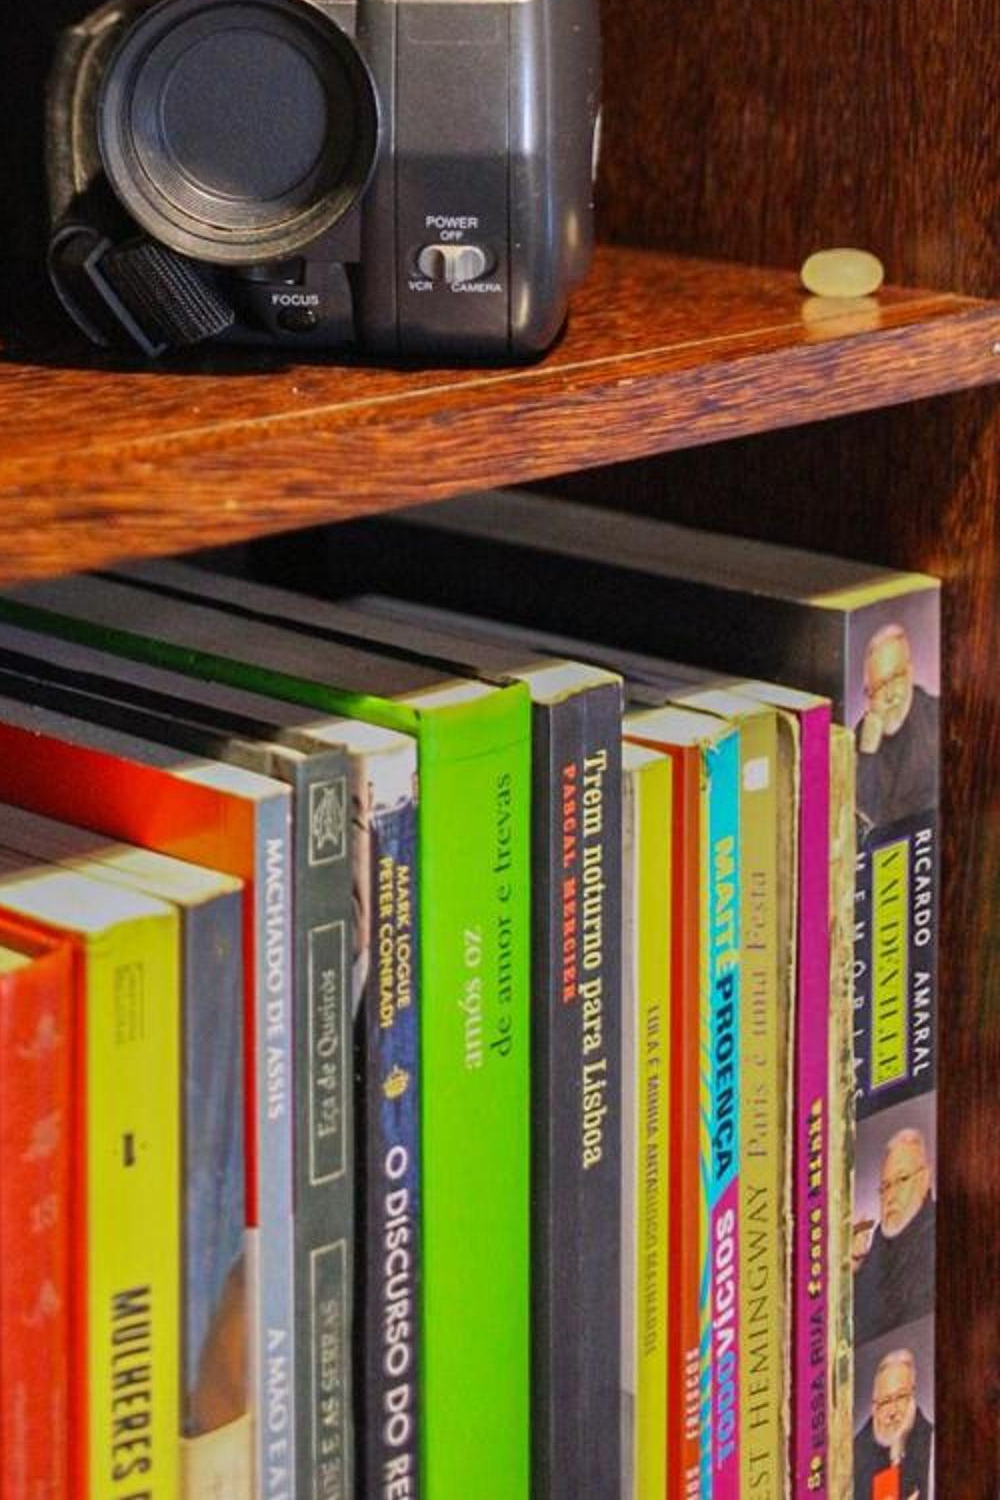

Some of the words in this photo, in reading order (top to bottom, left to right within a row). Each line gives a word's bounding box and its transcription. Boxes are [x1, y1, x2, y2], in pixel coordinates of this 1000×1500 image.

[426, 216, 478, 229] POWER
[440, 230, 463, 241] OFF
[271, 294, 319, 305] FOCUS
[408, 281, 433, 292] VCR
[451, 282, 502, 293] CAMERA
[493, 773, 512, 874] trevas
[562, 763, 577, 867] PASCAL
[583, 749, 607, 838] Trem
[266, 837, 285, 993] MACHADO
[378, 856, 394, 919] PETER
[395, 865, 410, 923] MARK
[499, 885, 513, 902] e
[583, 845, 607, 970] noturno
[746, 871, 767, 950] Festa
[914, 829, 932, 947] RICARDO
[378, 923, 396, 1029] CONRADI
[395, 929, 410, 1010] LOGUE
[463, 927, 483, 970] oz
[498, 914, 512, 1011] amor
[562, 879, 577, 1002] MERCIER
[266, 999, 285, 1036] DE
[457, 981, 483, 1070] amós
[490, 1019, 511, 1057] de
[581, 978, 602, 1052] para
[913, 971, 931, 1077] AMARAL
[267, 1043, 285, 1120] ASSIS
[317, 1063, 336, 1089] de
[583, 1059, 607, 1170] Lisboa
[747, 1084, 767, 1159] Paris
[385, 1145, 408, 1180] O
[384, 1187, 409, 1377] DISCURSO
[747, 1185, 771, 1431] HEMINGWAY
[267, 1328, 286, 1351] A
[110, 1285, 152, 1482] MULHERES
[384, 1383, 409, 1448] DO
